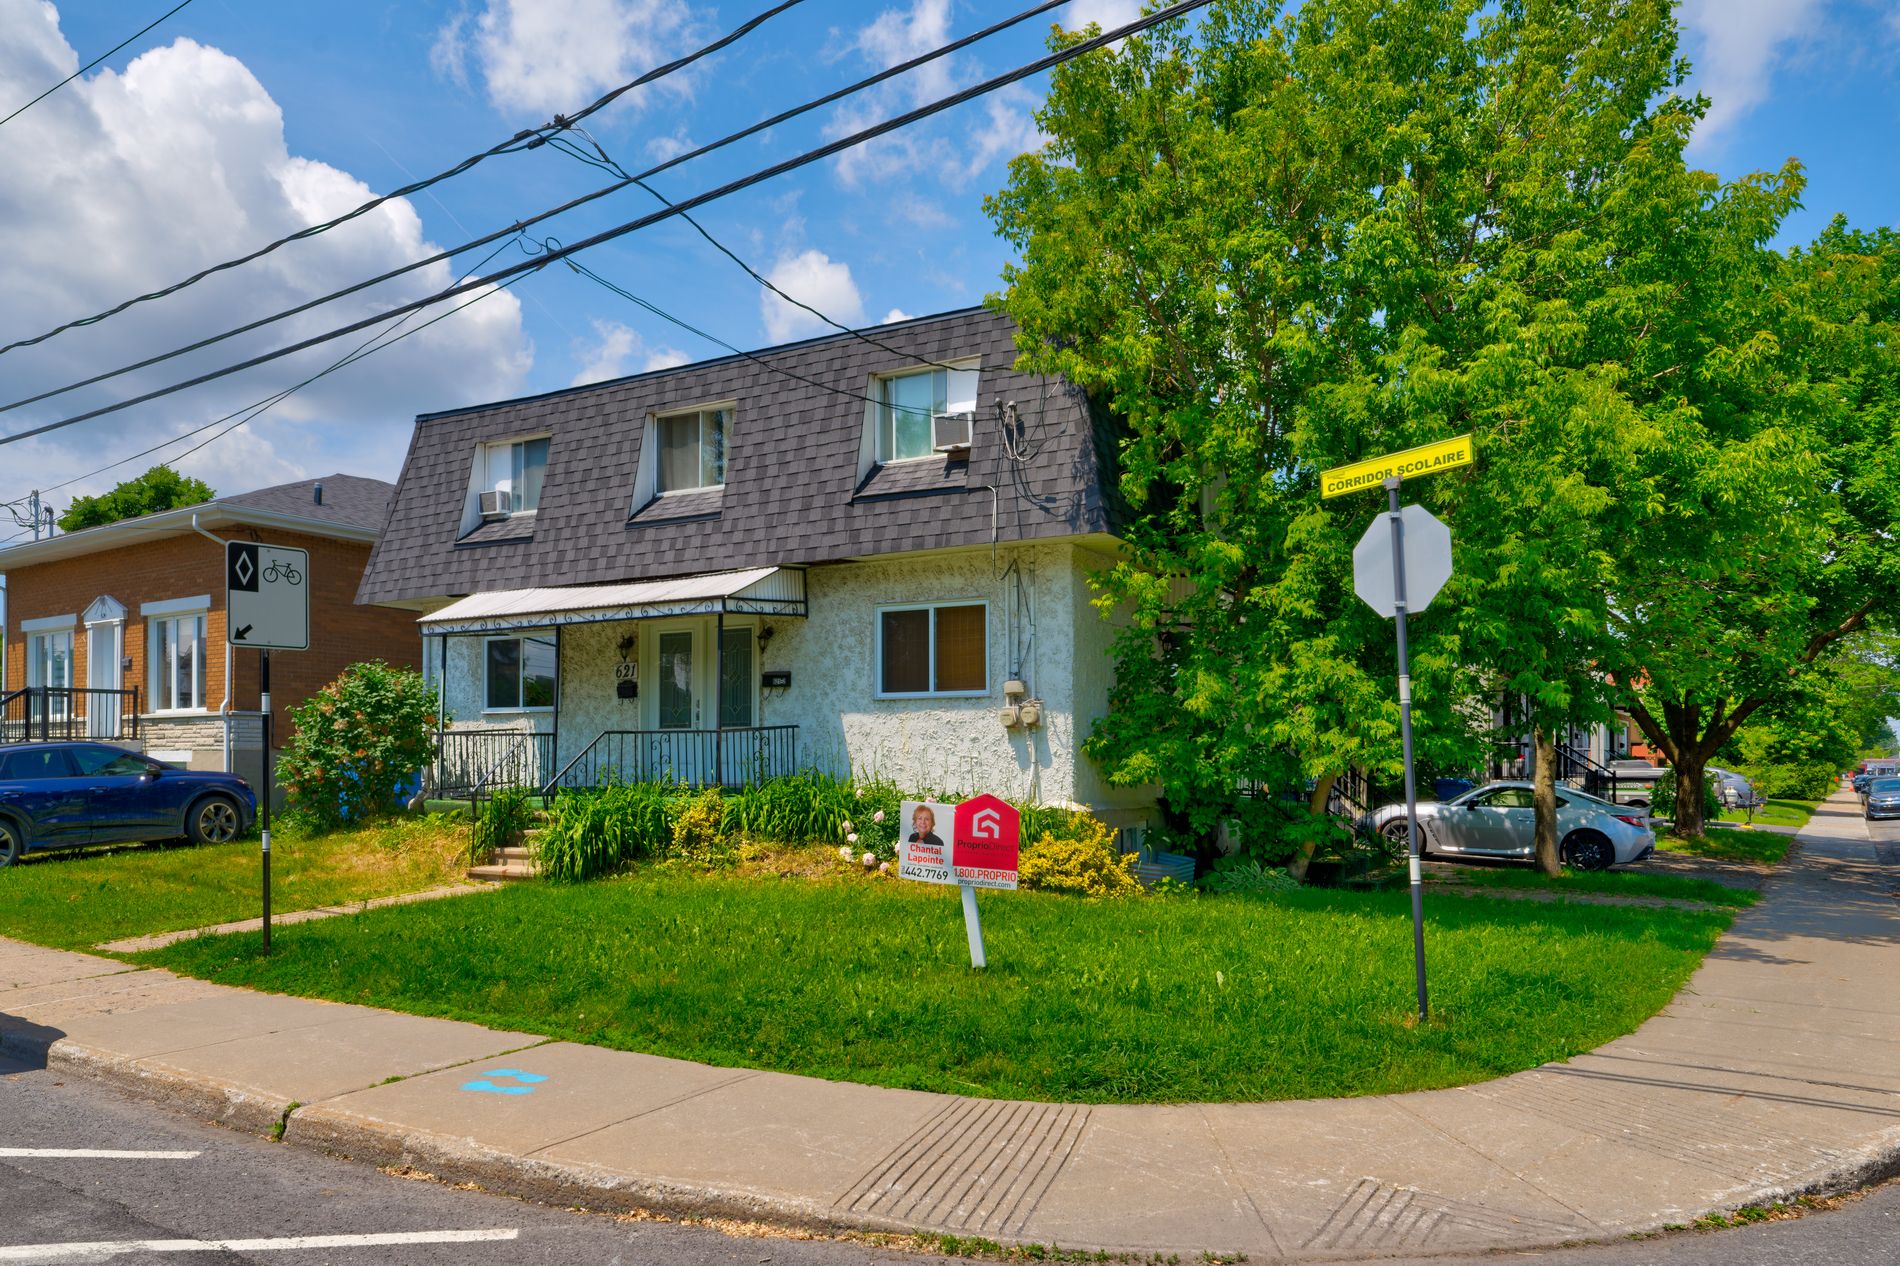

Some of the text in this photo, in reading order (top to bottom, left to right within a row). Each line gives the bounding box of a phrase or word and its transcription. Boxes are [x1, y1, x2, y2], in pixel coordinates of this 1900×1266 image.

[1327, 450, 1465, 493] CORRIDOR SCOLAIRE
[615, 663, 636, 679] 621
[910, 843, 943, 856] Chantal
[907, 853, 945, 865] Lapointe
[905, 866, 949, 880] 442.7769
[957, 878, 1012, 889] propriodirect.com
